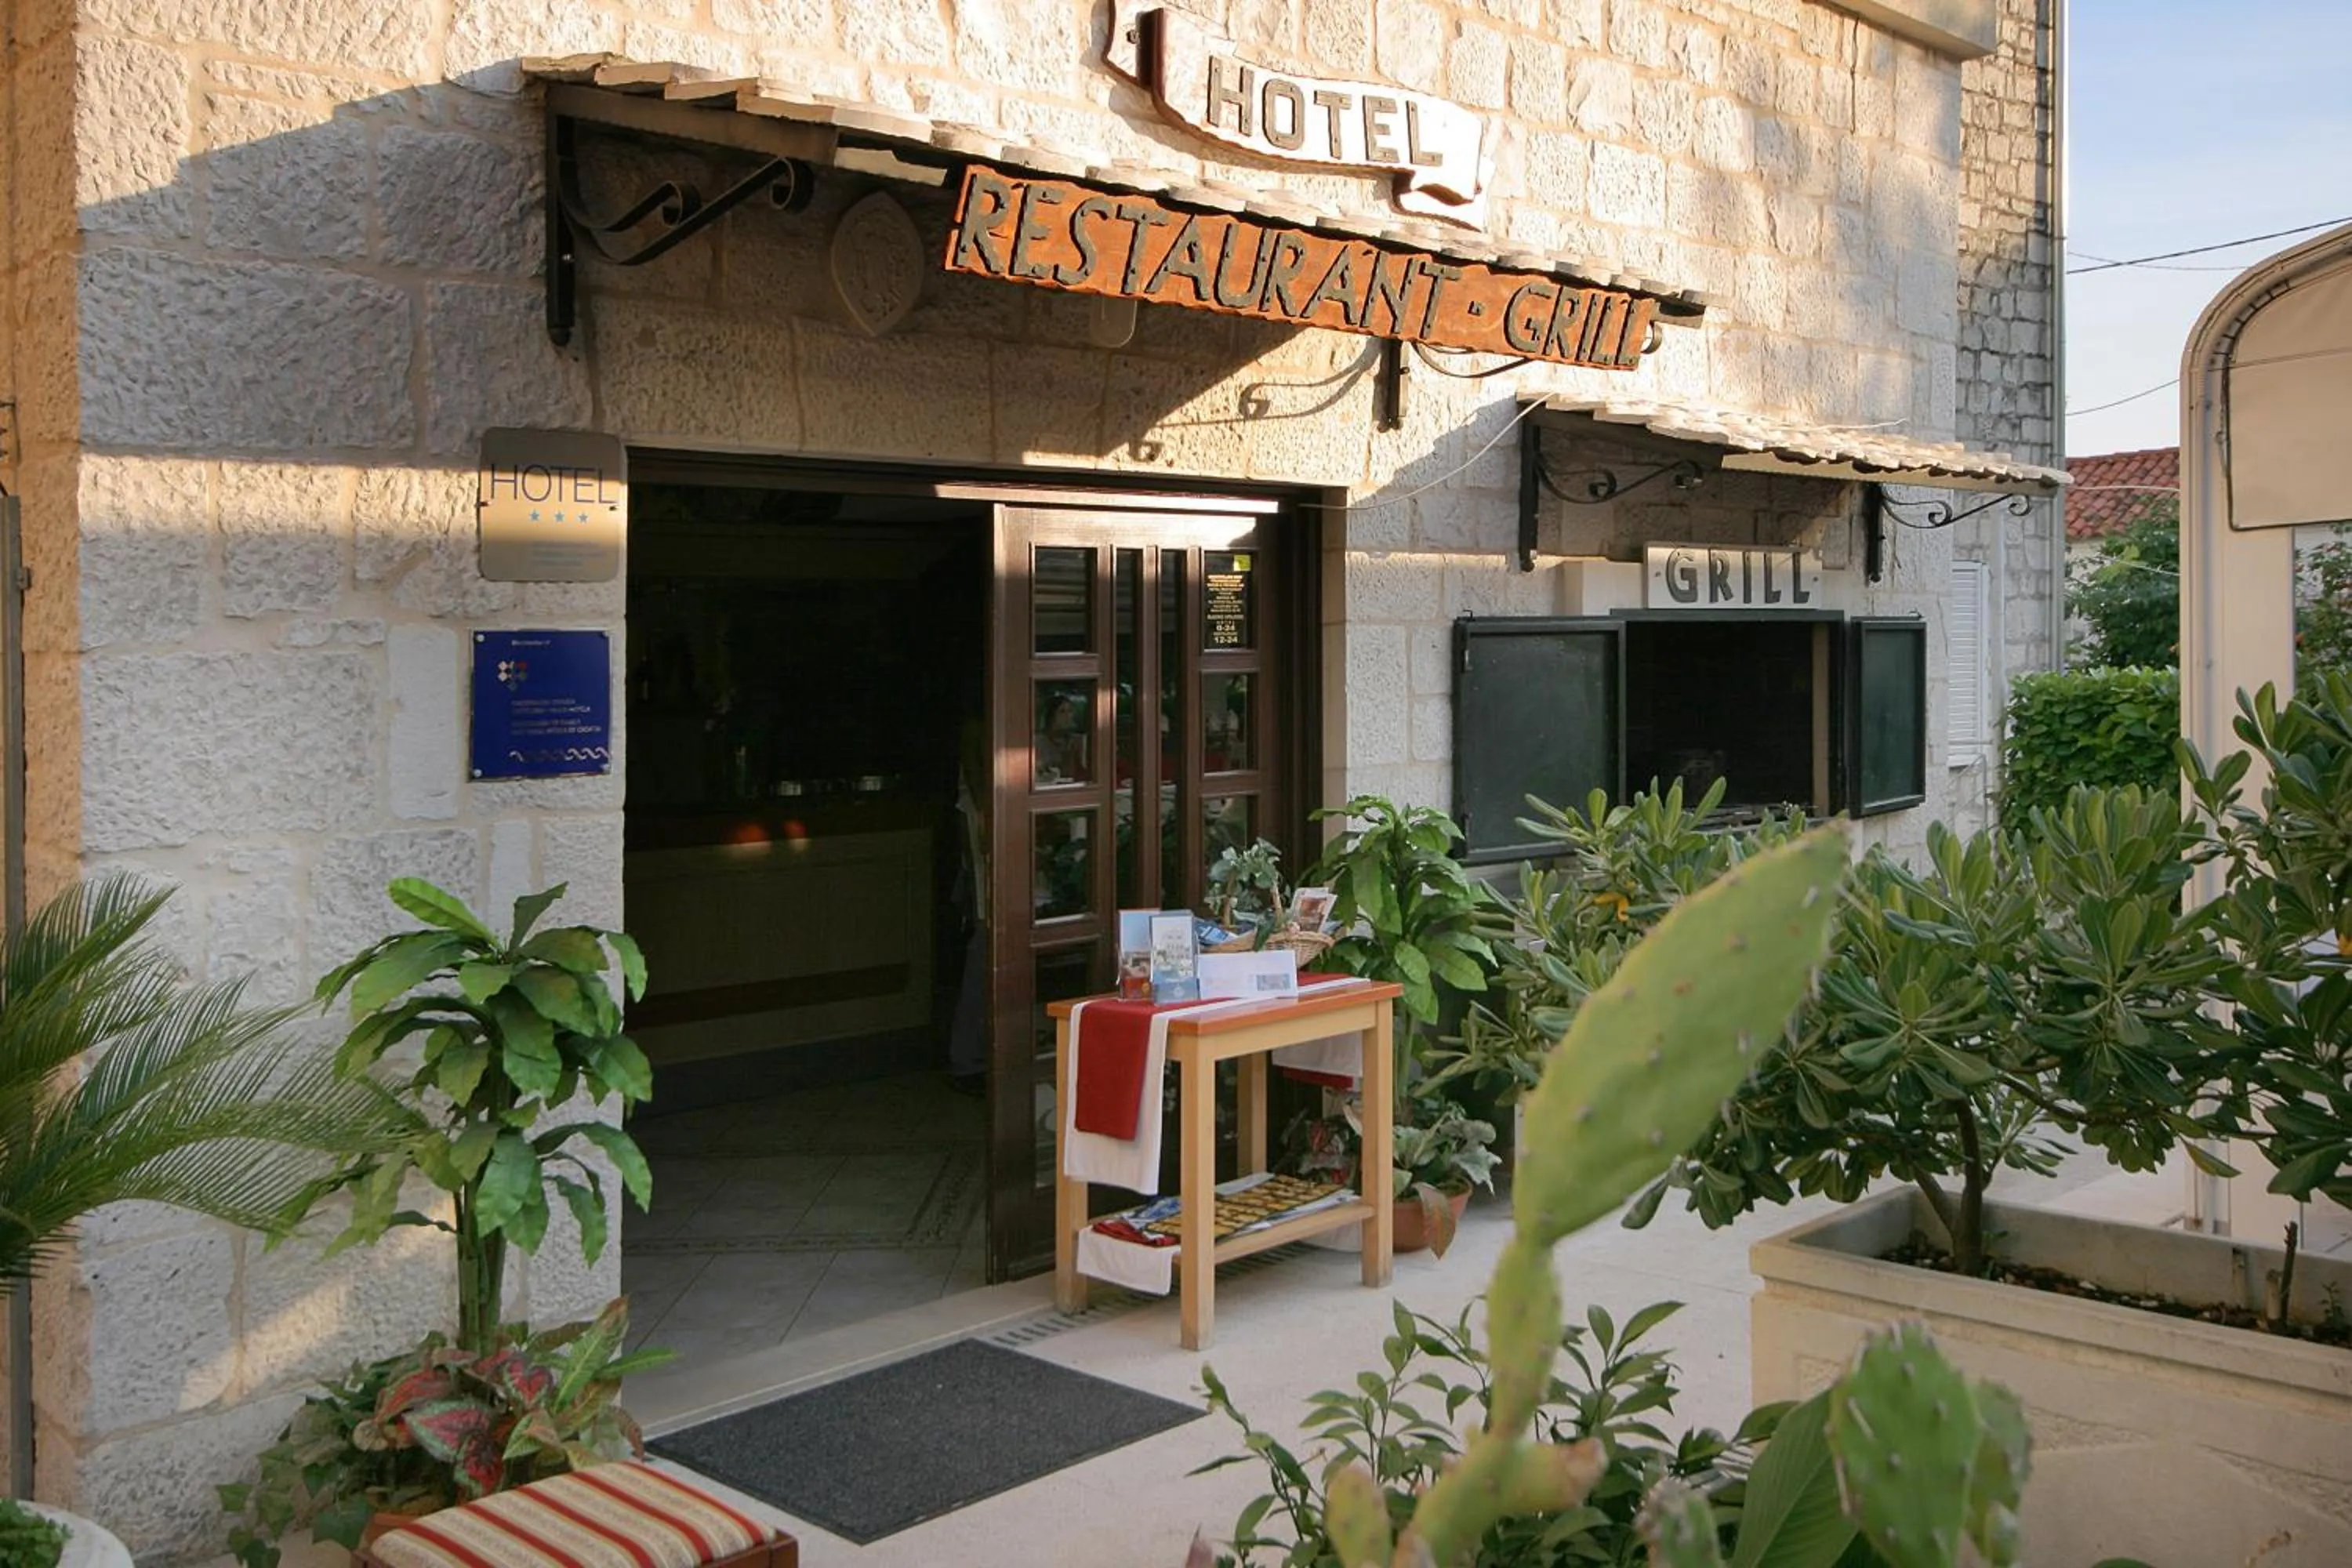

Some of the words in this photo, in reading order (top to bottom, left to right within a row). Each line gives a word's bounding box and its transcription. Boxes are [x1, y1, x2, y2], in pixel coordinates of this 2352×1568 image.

[1207, 55, 1443, 166] HOTEL
[953, 172, 1462, 339] RESTAURANT
[1503, 281, 1641, 366] GRILL
[490, 464, 618, 504] HOTEL
[1665, 548, 1810, 604] GRILL
